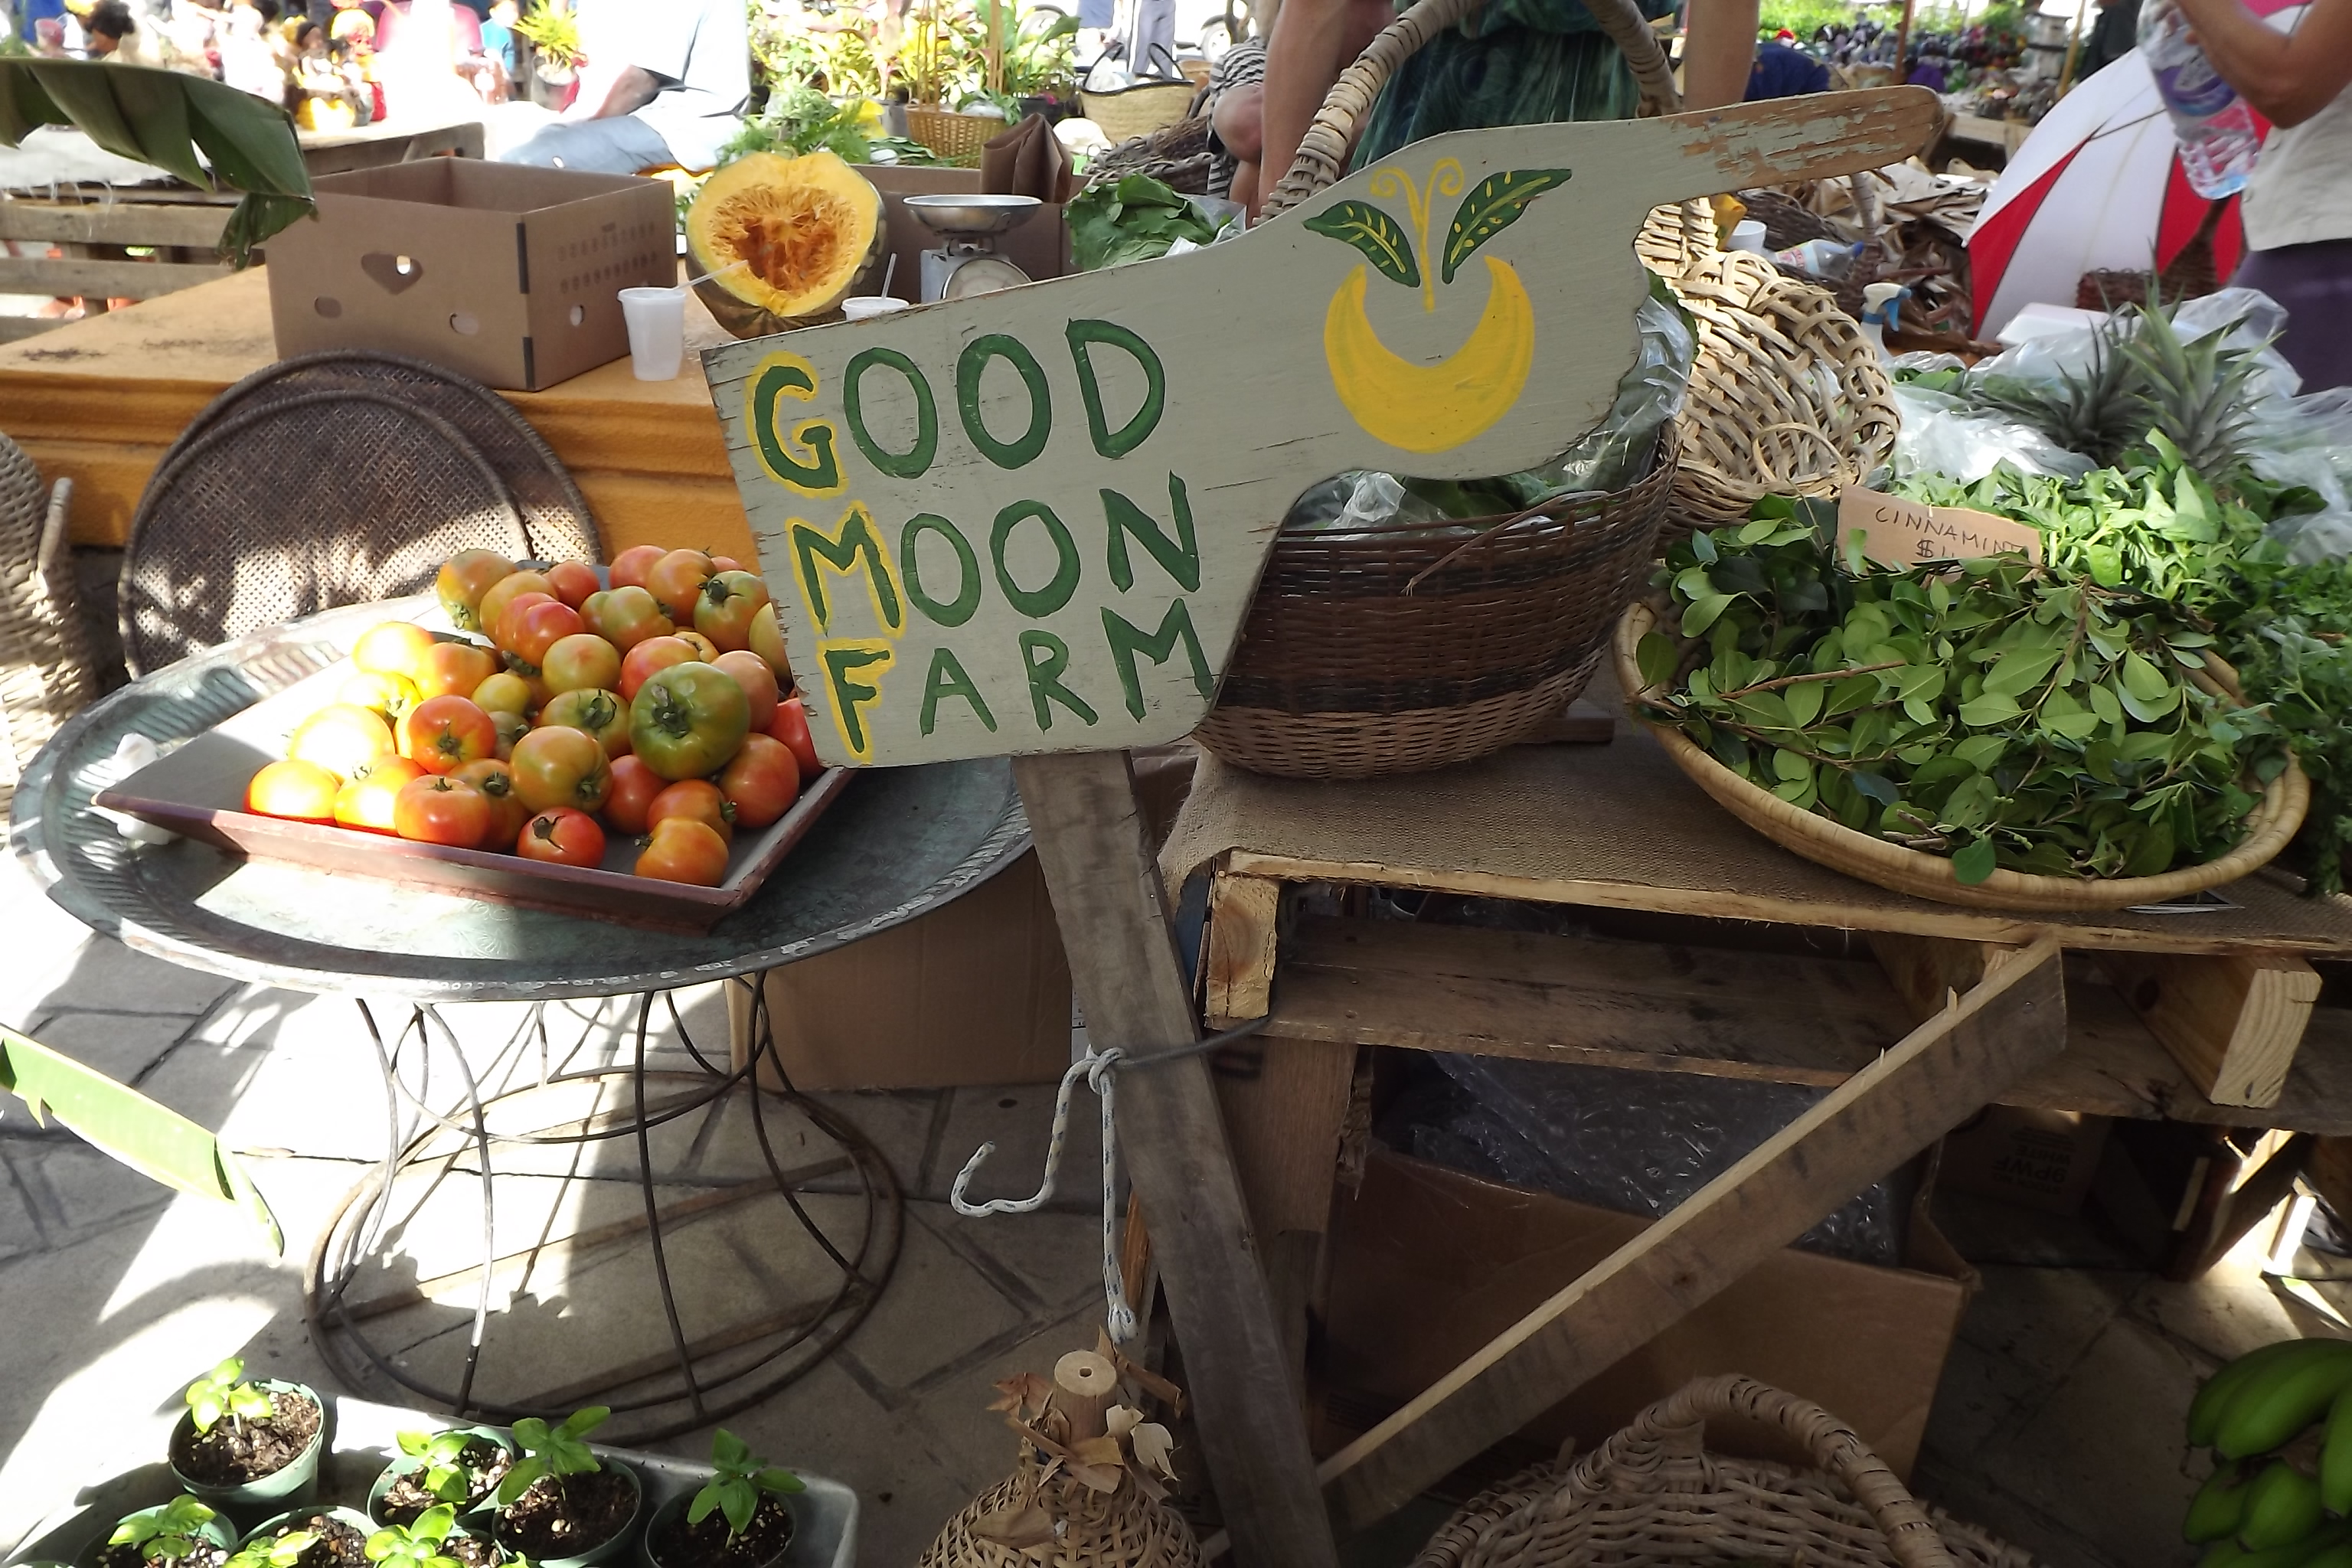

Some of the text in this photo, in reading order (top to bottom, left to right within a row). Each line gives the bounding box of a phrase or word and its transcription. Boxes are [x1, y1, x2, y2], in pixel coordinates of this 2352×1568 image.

[747, 318, 1166, 495] GOOD
[789, 470, 1200, 635] MOON
[821, 598, 1216, 756] FARM
[1992, 1156, 2067, 1183] 9PWF
[2016, 1145, 2070, 1165] WHITE
